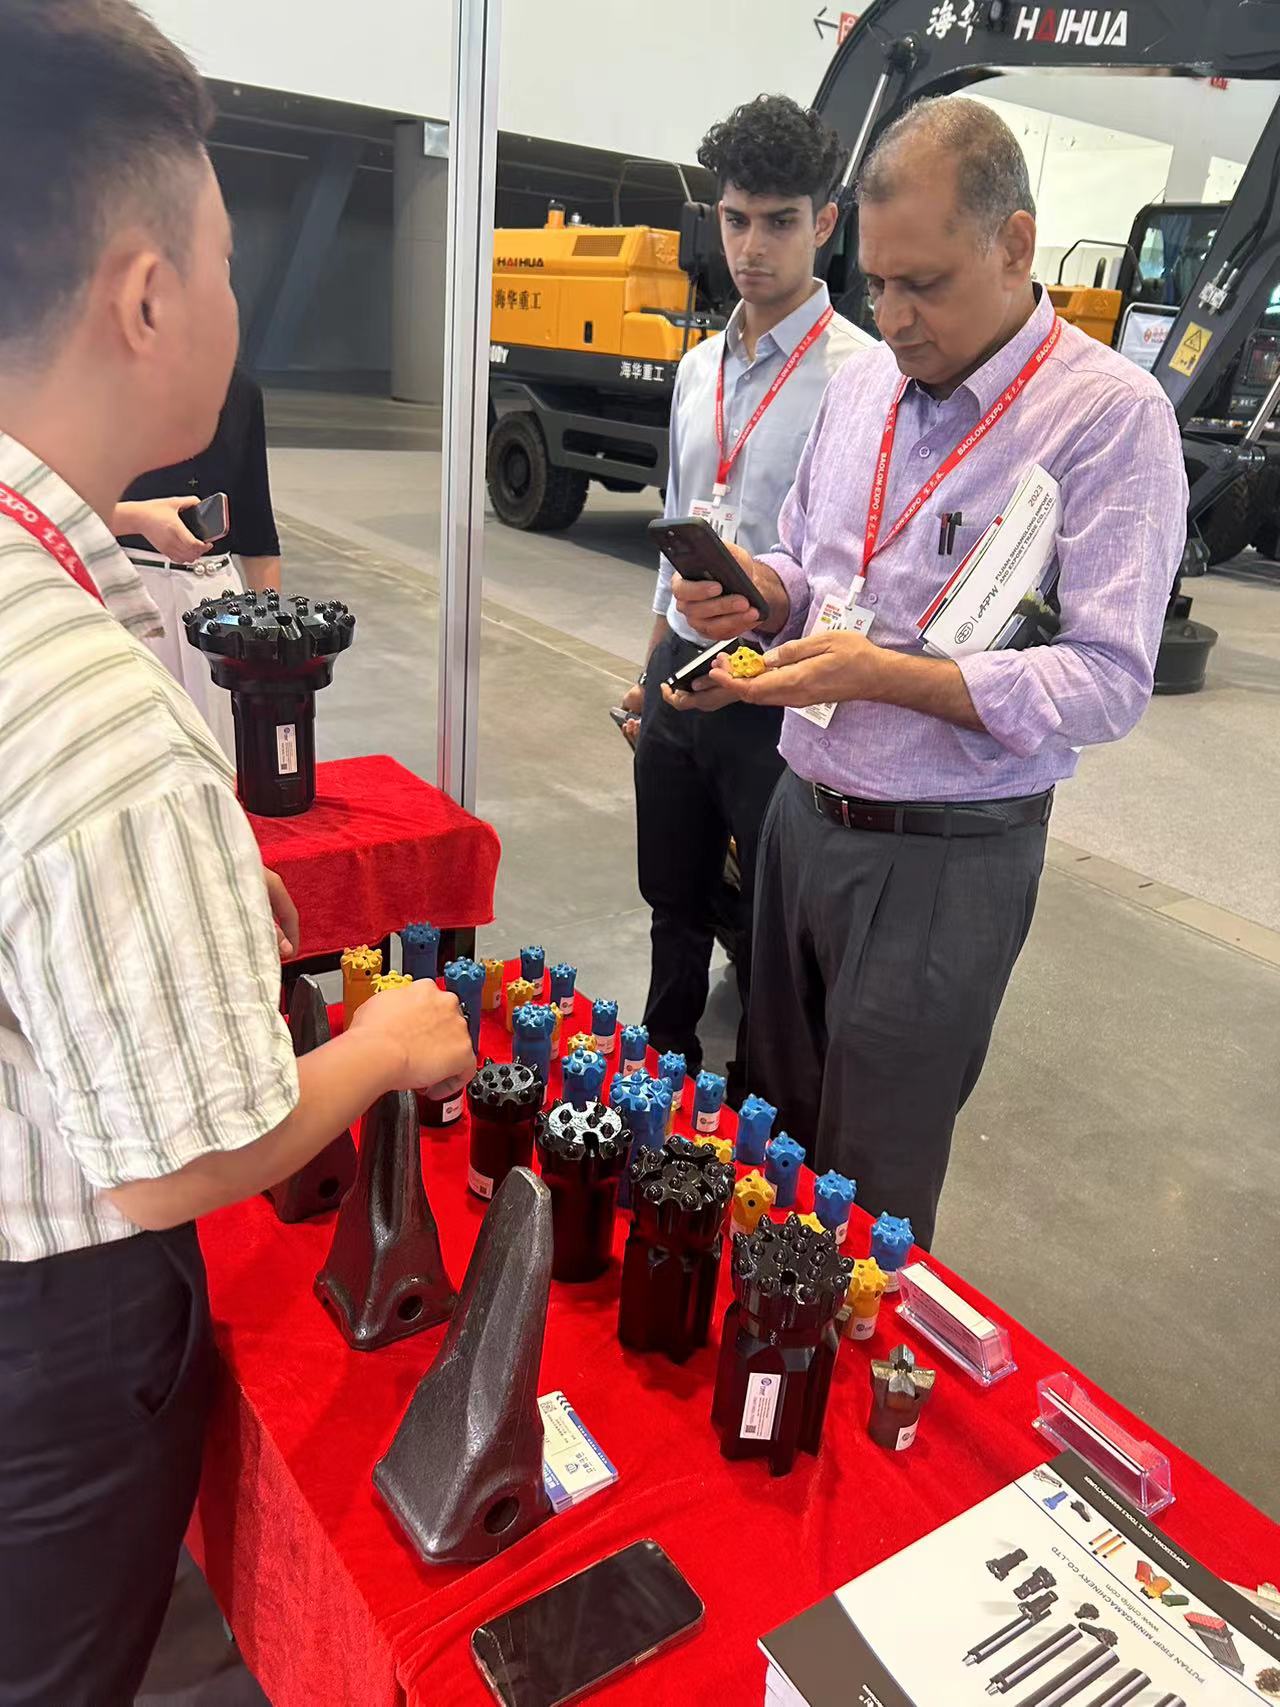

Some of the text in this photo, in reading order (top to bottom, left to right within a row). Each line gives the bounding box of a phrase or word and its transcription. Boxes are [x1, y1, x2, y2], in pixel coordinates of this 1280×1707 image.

[1012, 5, 1127, 46] HAIHUA
[496, 257, 543, 266] HAIHUA
[619, 361, 664, 381] 海华重工
[956, 402, 1004, 456] BAOLON-EXPO
[872, 452, 887, 509] BAOLON-EXPO
[1027, 484, 1043, 507] 2023
[994, 492, 1050, 580] FUJIAN SHUANGLONG IMPORT
[998, 569, 1009, 583] AND
[1007, 544, 1026, 569] EXPORT
[1023, 523, 1038, 545] TRADE
[1151, 1534, 1190, 1569] PROFESSIONAL
[1077, 1571, 1154, 1640] MINING&MACHINERY
[1152, 1637, 1174, 1658] FIRIP
[1173, 1655, 1205, 1683] PUTIAN
